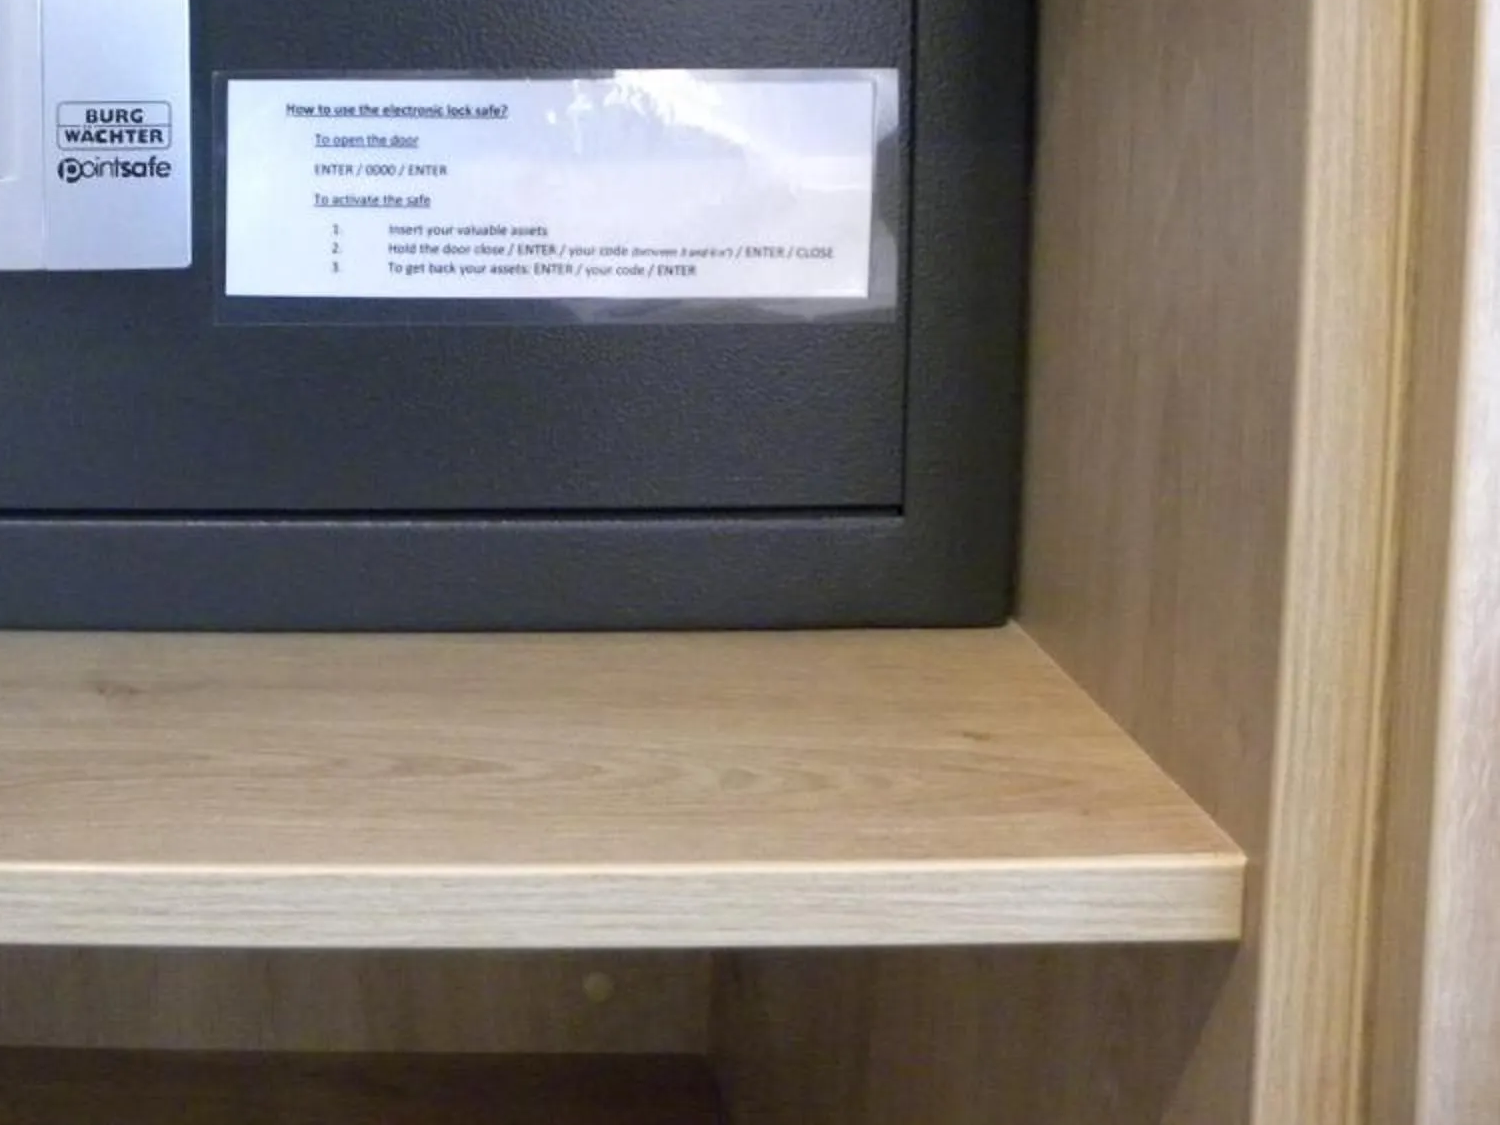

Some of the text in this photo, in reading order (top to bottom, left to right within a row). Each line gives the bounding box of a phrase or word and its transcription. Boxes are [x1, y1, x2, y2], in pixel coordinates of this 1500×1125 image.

[85, 108, 144, 124] BURG
[286, 104, 509, 118] How to use the electronic lock safe?
[315, 133, 419, 148] To open the door
[314, 163, 354, 176] ENTER
[365, 164, 397, 176] 0000
[408, 164, 447, 176] ENTER
[314, 193, 431, 207] To activate the safe
[388, 225, 423, 236] Insert
[427, 227, 454, 238] your
[458, 225, 508, 236] valuable
[511, 226, 548, 236] assets
[388, 243, 417, 254] Hold
[420, 243, 440, 254] the
[443, 243, 471, 254] door
[474, 244, 505, 255] close
[518, 245, 557, 256] ENTER
[569, 248, 596, 259] your
[599, 245, 628, 257] code
[745, 246, 785, 259] ENTER
[796, 246, 834, 259] CLOSE
[388, 262, 403, 273] To
[405, 263, 425, 276] get
[428, 262, 455, 274] back
[459, 265, 486, 277] your
[533, 264, 573, 275] ENTER
[585, 266, 612, 277] your
[615, 264, 645, 276] code
[657, 264, 697, 277] ENTER
